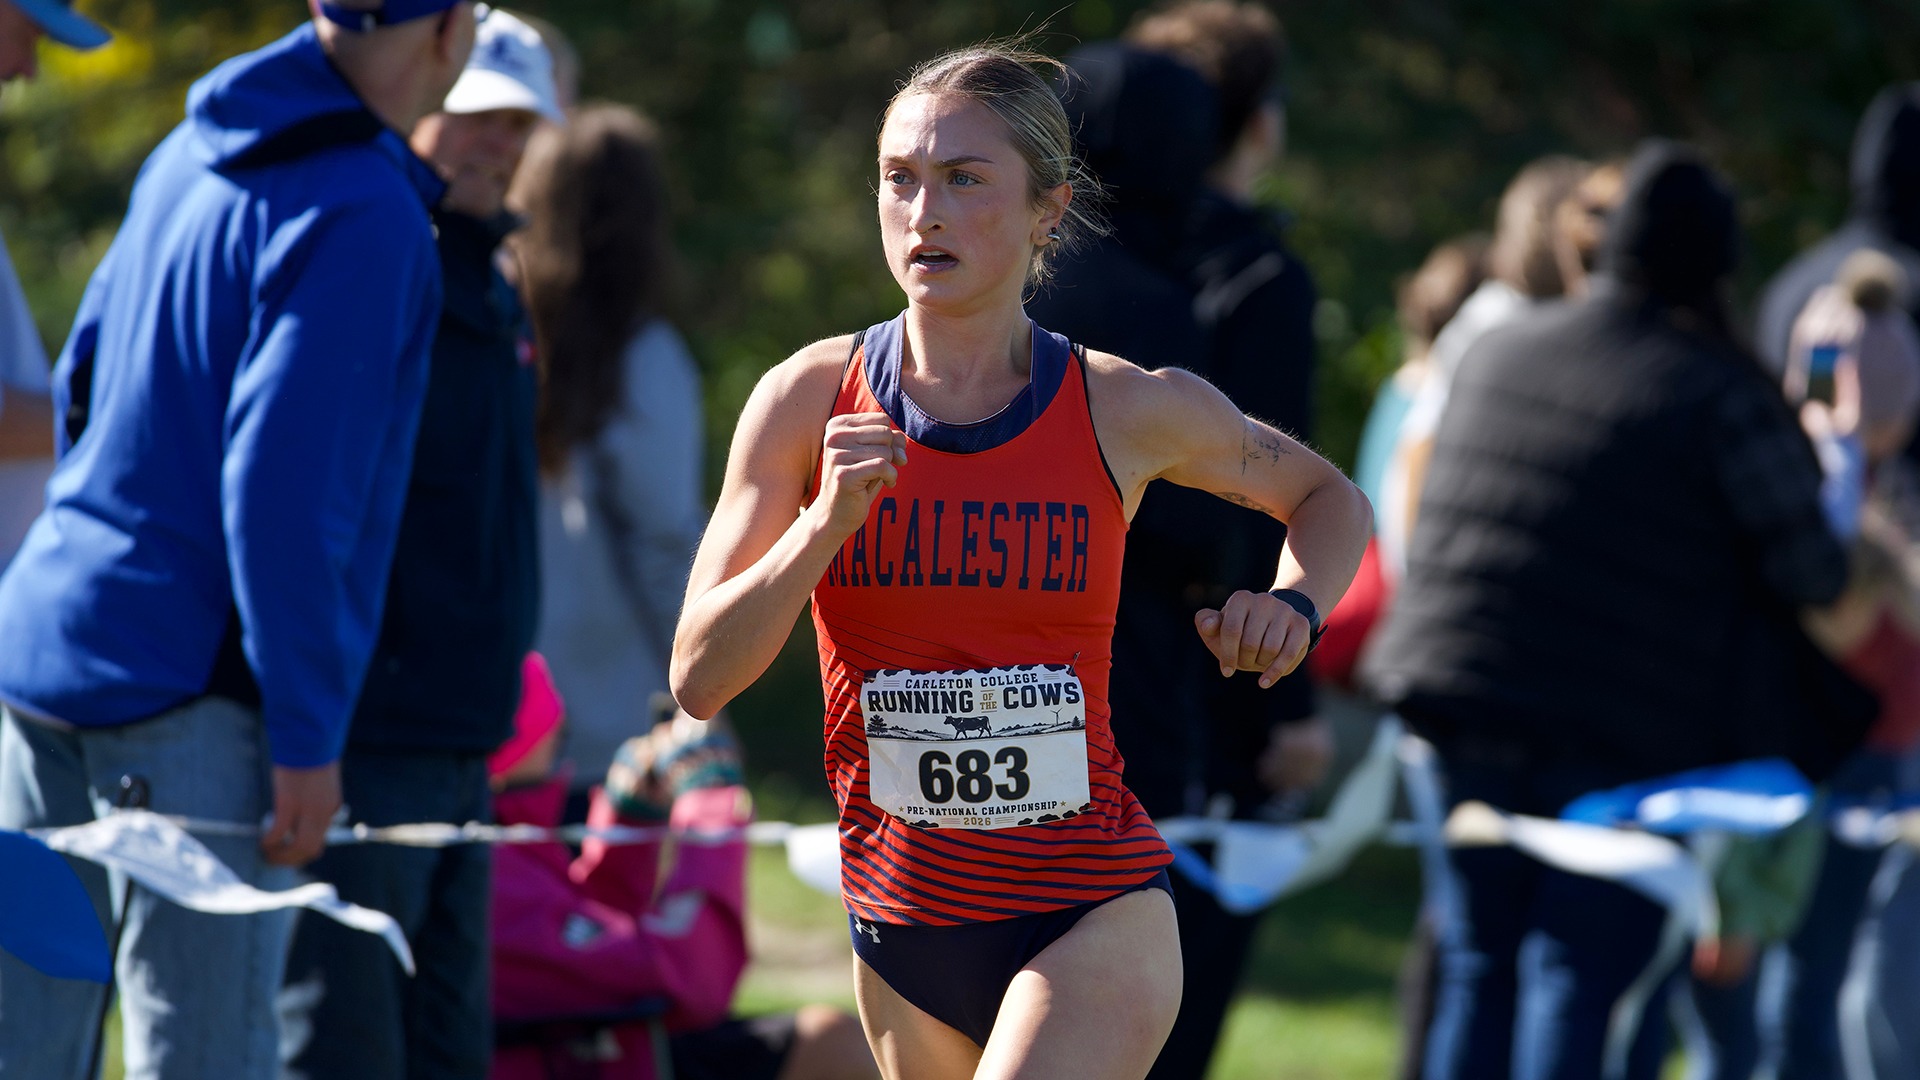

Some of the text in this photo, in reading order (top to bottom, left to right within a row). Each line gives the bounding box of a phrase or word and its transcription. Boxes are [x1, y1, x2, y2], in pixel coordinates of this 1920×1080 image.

[905, 673, 1038, 689] CARLETON COLLEGE
[867, 682, 1080, 714] RUNNING OF THE COWS
[918, 746, 1031, 804] 683
[907, 801, 1058, 816] PRE-NATIONAL CHAMPIONSHIP
[963, 817, 992, 826] 2026
